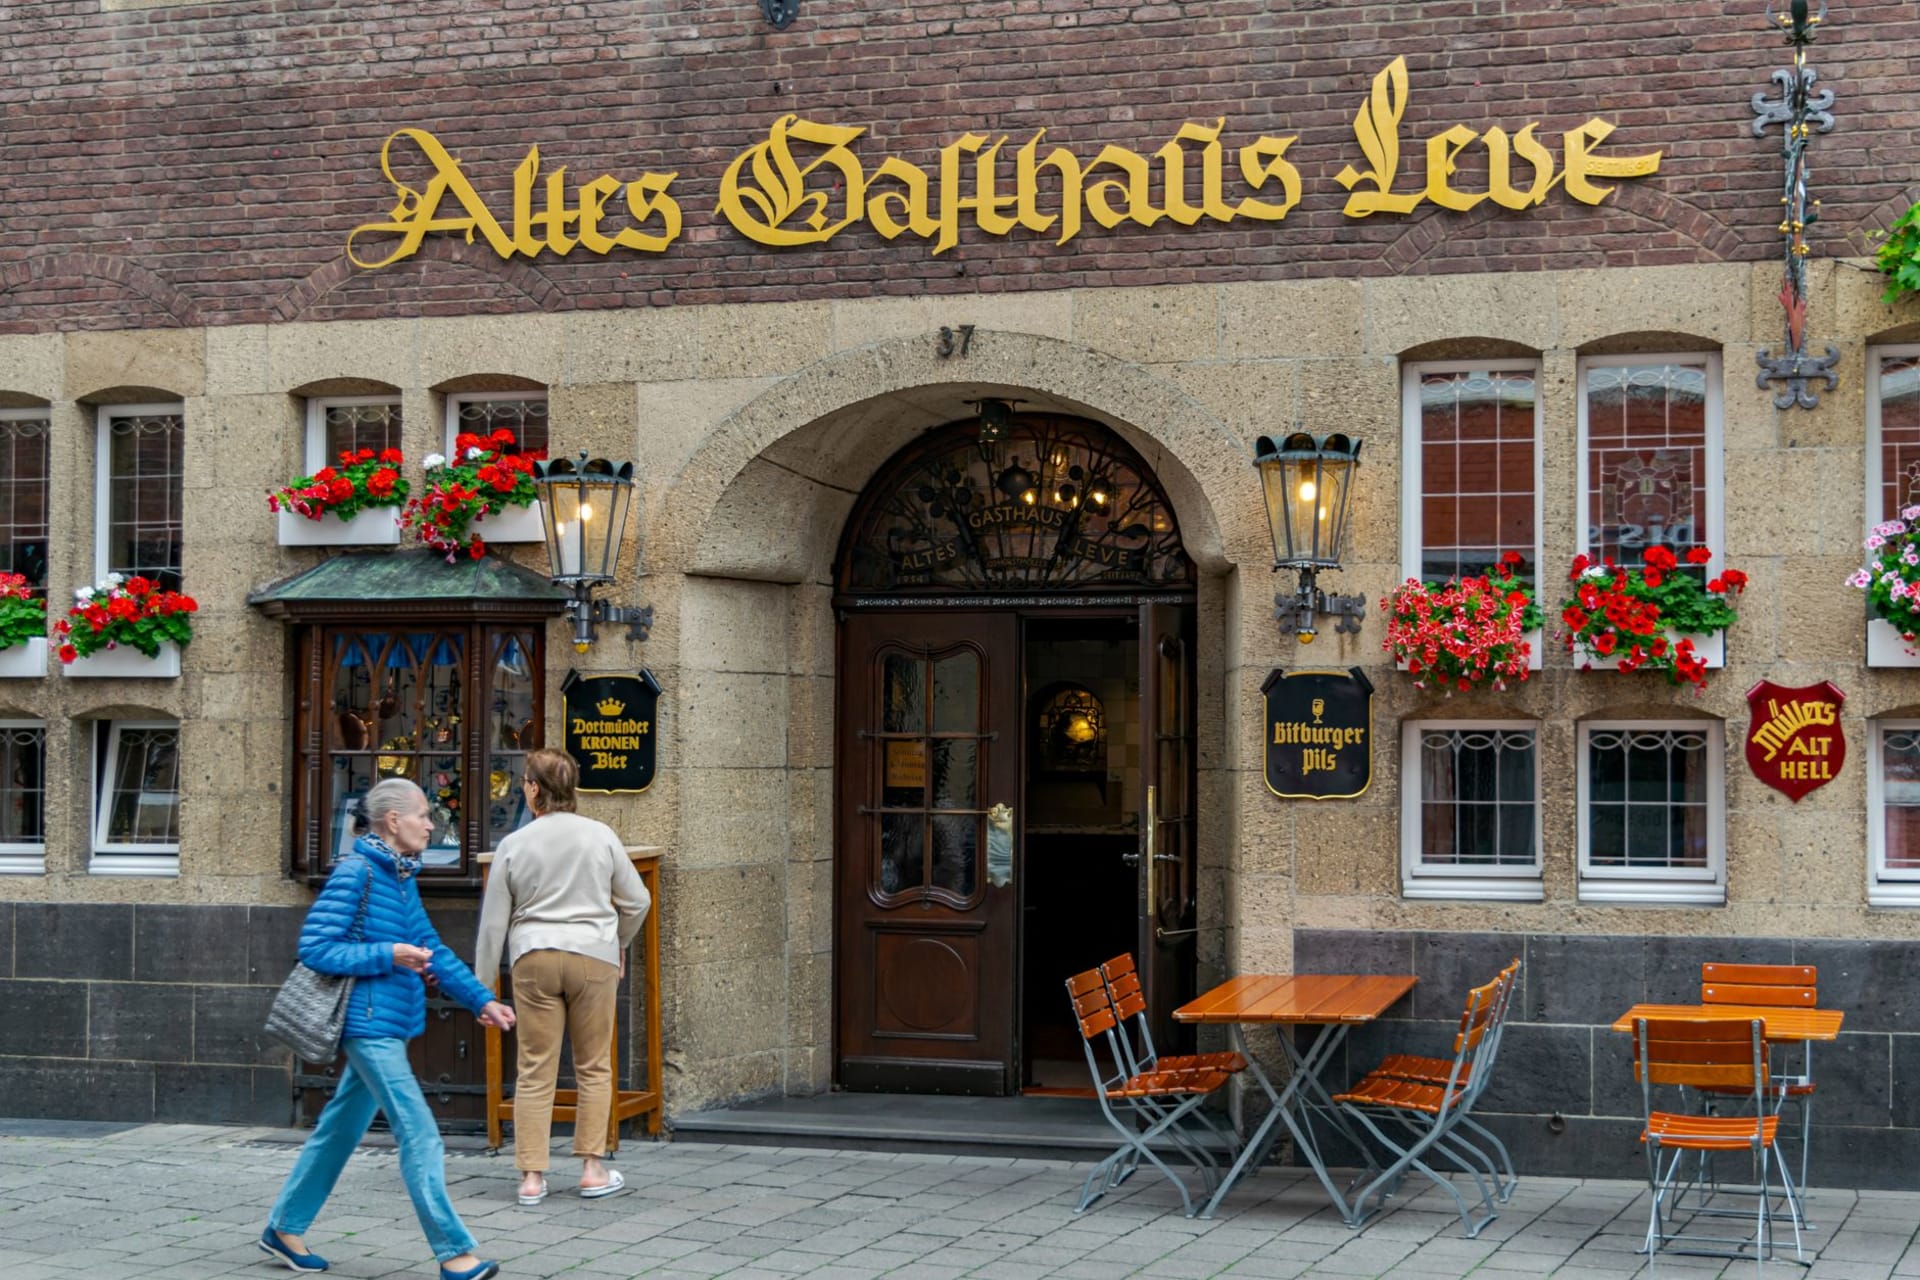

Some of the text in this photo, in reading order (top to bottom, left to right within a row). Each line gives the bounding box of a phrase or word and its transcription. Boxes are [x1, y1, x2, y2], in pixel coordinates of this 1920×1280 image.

[347, 127, 683, 269] Altes
[1333, 54, 1663, 218] Leve
[936, 324, 976, 358] 37
[968, 506, 1064, 528] GASTHAUS
[901, 542, 958, 570] ALTES
[1074, 537, 1129, 566] LEVE
[581, 736, 640, 750] KRONEN
[1273, 721, 1364, 750] Bitburger
[1751, 698, 1836, 762] Müllers
[1787, 736, 1832, 755] ALT
[590, 751, 627, 770] Bier
[1302, 748, 1337, 776] Pils
[1780, 761, 1832, 779] HELL
